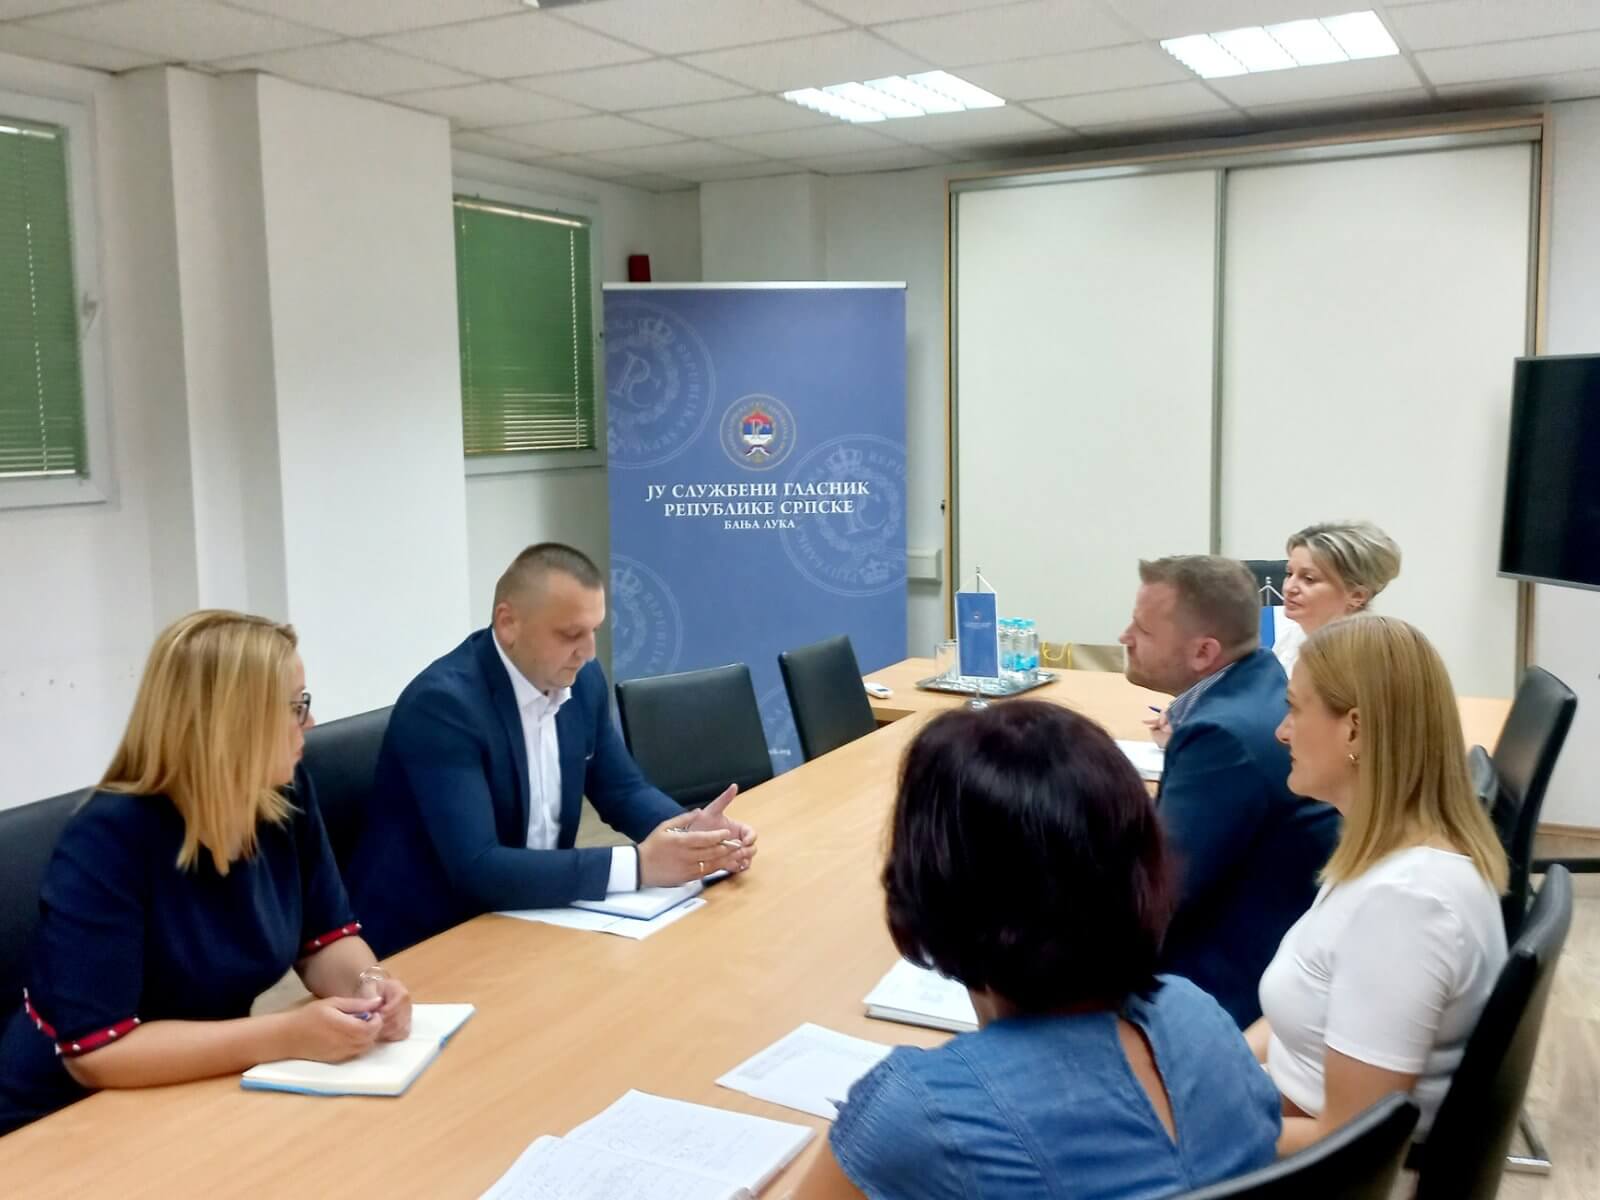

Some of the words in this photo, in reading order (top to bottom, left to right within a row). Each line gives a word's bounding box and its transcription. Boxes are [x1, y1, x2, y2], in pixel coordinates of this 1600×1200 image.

[645, 484, 666, 502] ЈУ
[671, 483, 778, 498] СЛУЖБЕНИ
[783, 481, 870, 496] ГЛАСНИК
[663, 501, 776, 517] РЕПУБЛИКЕ
[780, 499, 855, 514] СРПСКЕ
[723, 519, 760, 530] БАЊА
[763, 518, 796, 529] ЛУКА
